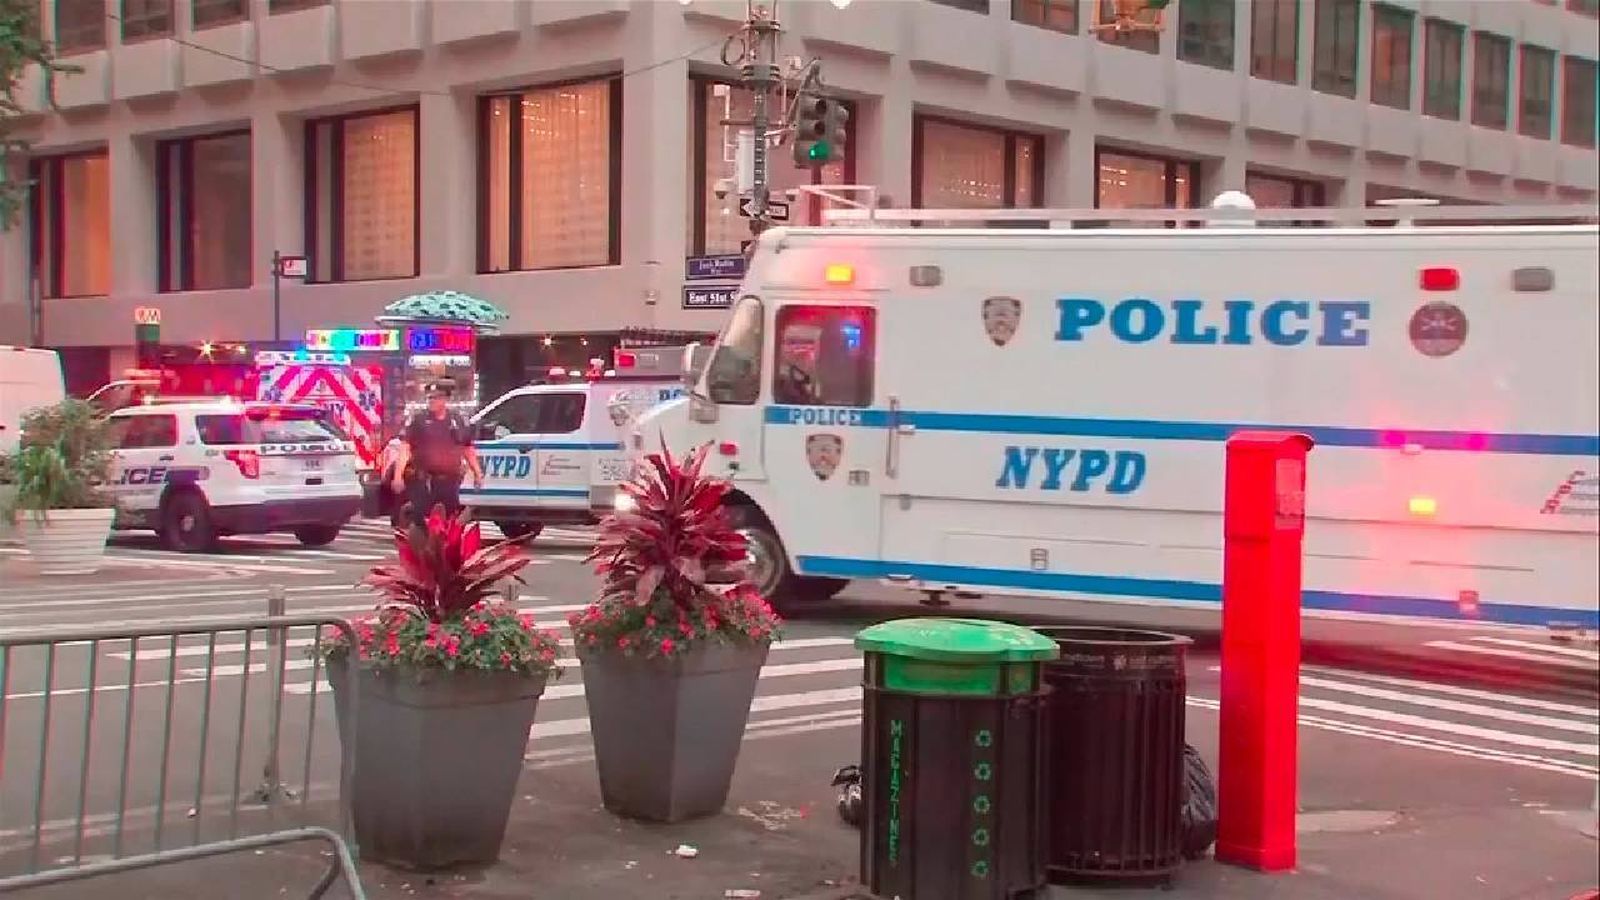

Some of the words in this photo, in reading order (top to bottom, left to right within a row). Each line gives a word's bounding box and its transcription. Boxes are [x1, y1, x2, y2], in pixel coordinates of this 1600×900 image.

[689, 292, 708, 305] East
[710, 292, 727, 305] 51st
[1054, 298, 1371, 346] POLICE
[789, 408, 861, 426] POLICE
[995, 446, 1146, 494] NYPD
[889, 719, 903, 863] MAGAZINES
